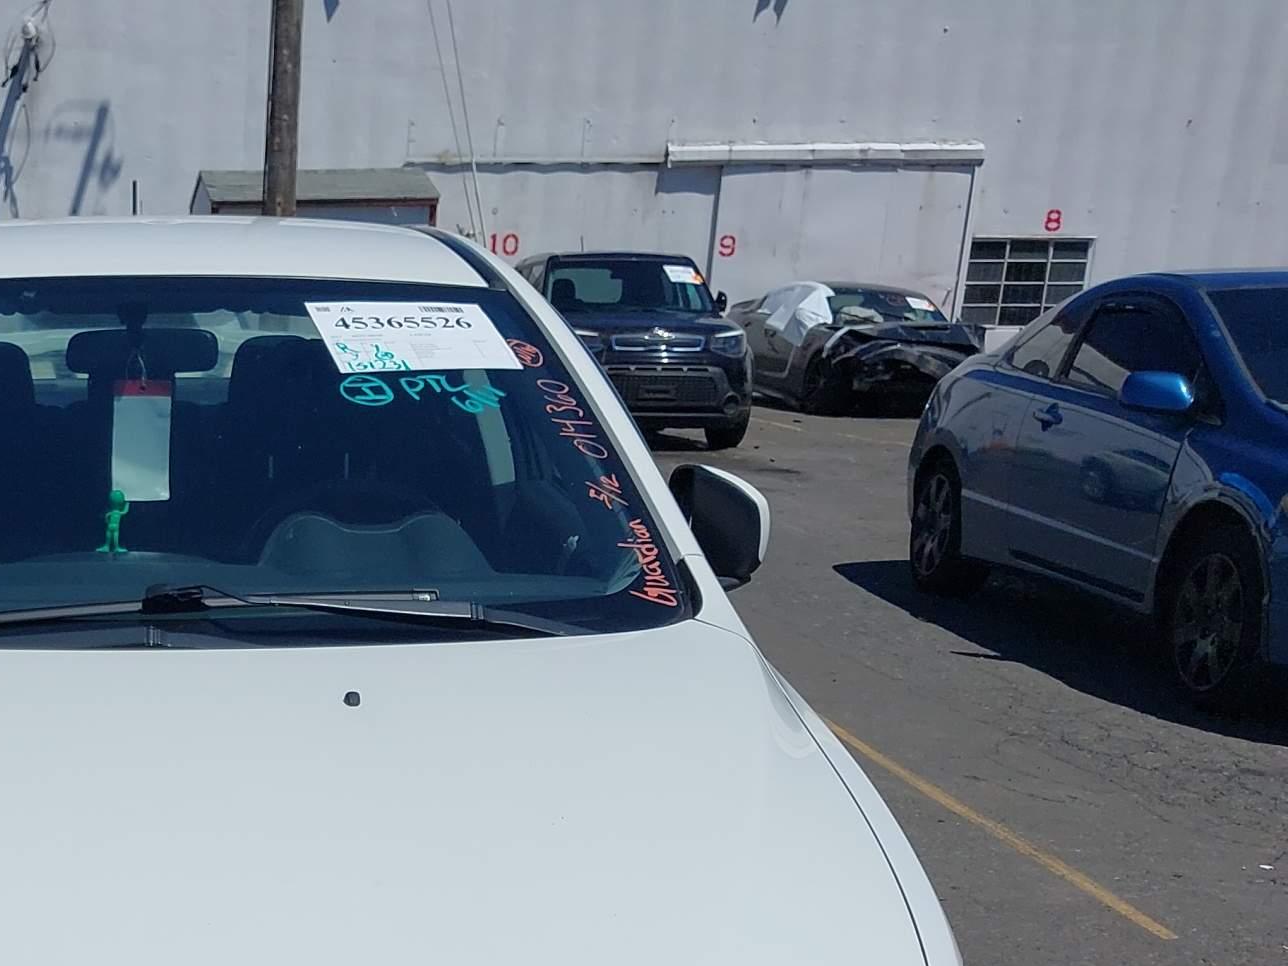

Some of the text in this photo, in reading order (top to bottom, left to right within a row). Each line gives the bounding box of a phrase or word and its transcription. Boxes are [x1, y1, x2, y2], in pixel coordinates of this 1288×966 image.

[1045, 208, 1062, 232] 8
[490, 233, 519, 256] 10
[718, 235, 736, 257] 9
[334, 316, 472, 330] 45365526
